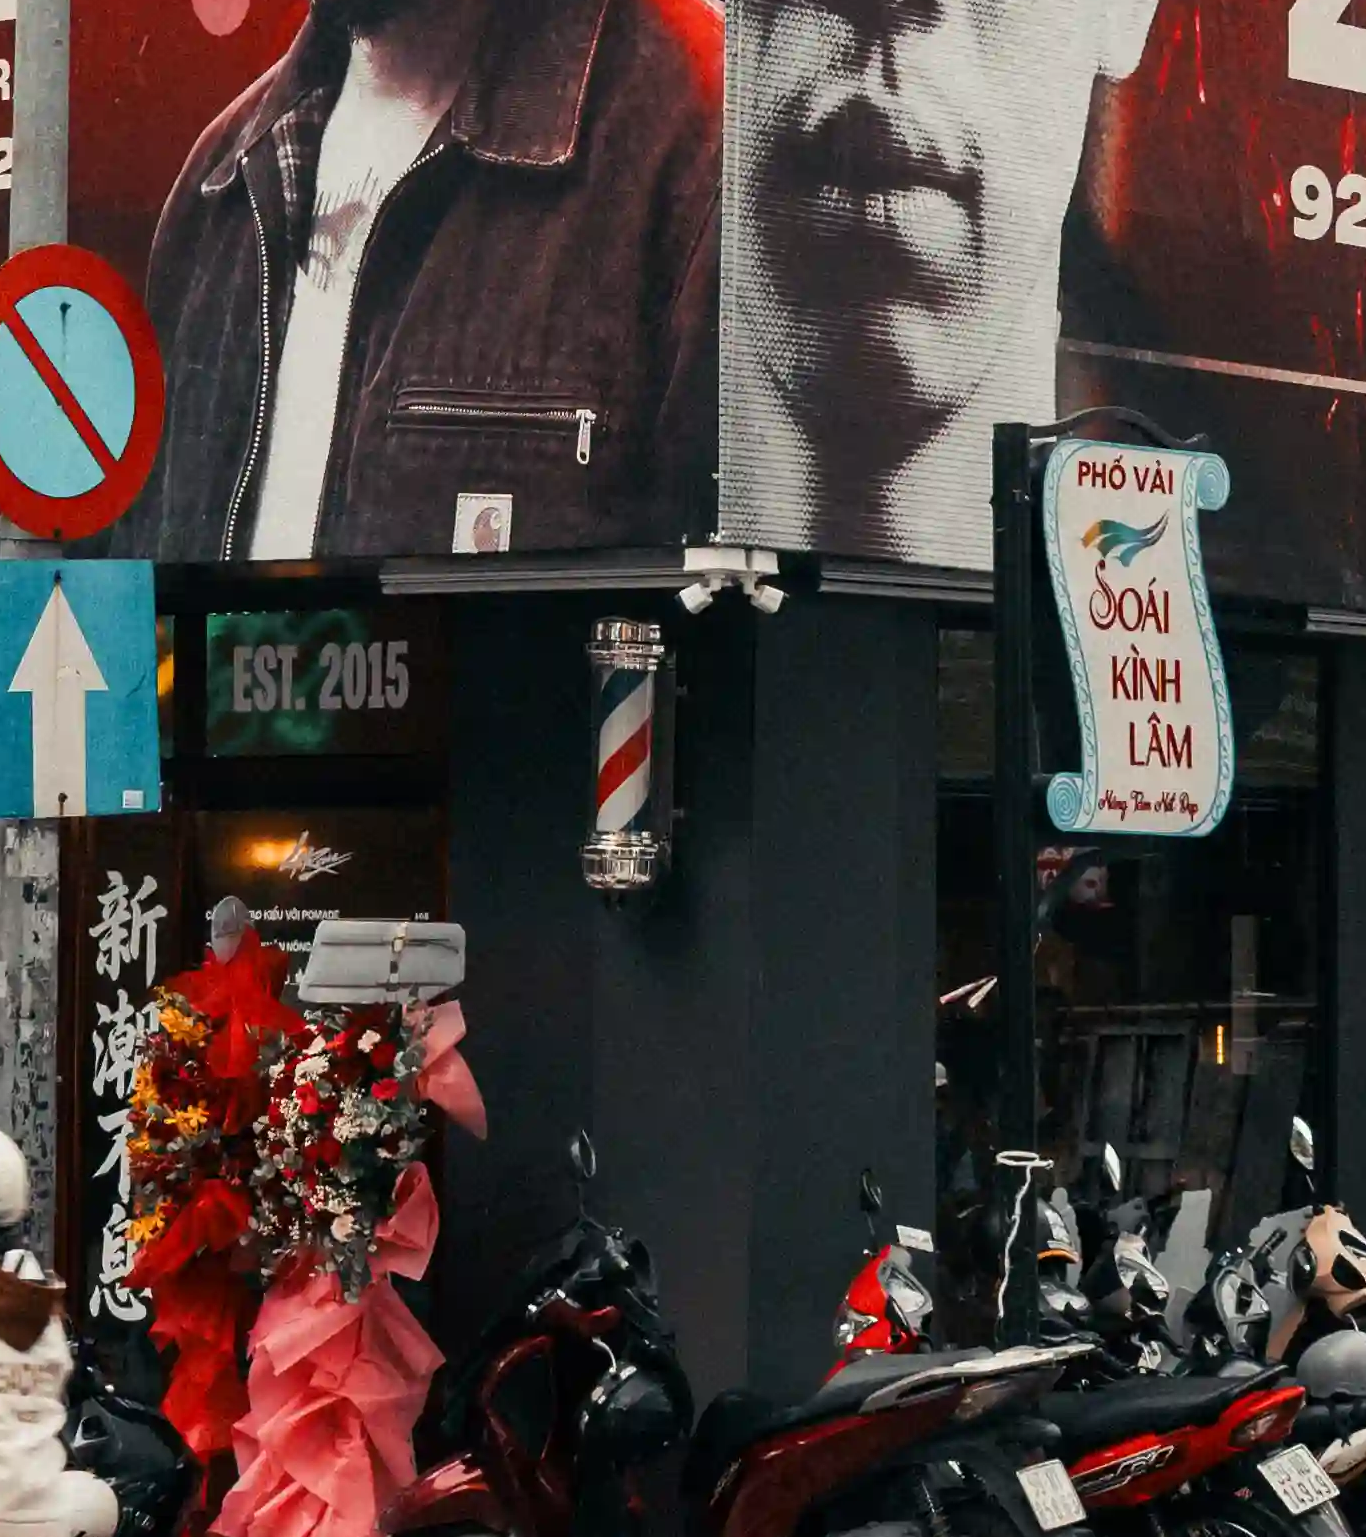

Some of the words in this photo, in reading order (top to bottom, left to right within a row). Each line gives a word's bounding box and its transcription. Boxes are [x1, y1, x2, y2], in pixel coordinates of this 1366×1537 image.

[1076, 453, 1126, 491] PHỐ
[1133, 458, 1174, 495] VẢI
[1088, 559, 1171, 635] SOÁI
[232, 641, 307, 713] EST.
[318, 640, 410, 711] 2015
[1110, 643, 1183, 704] KÌNH
[1128, 711, 1194, 770] LÂM
